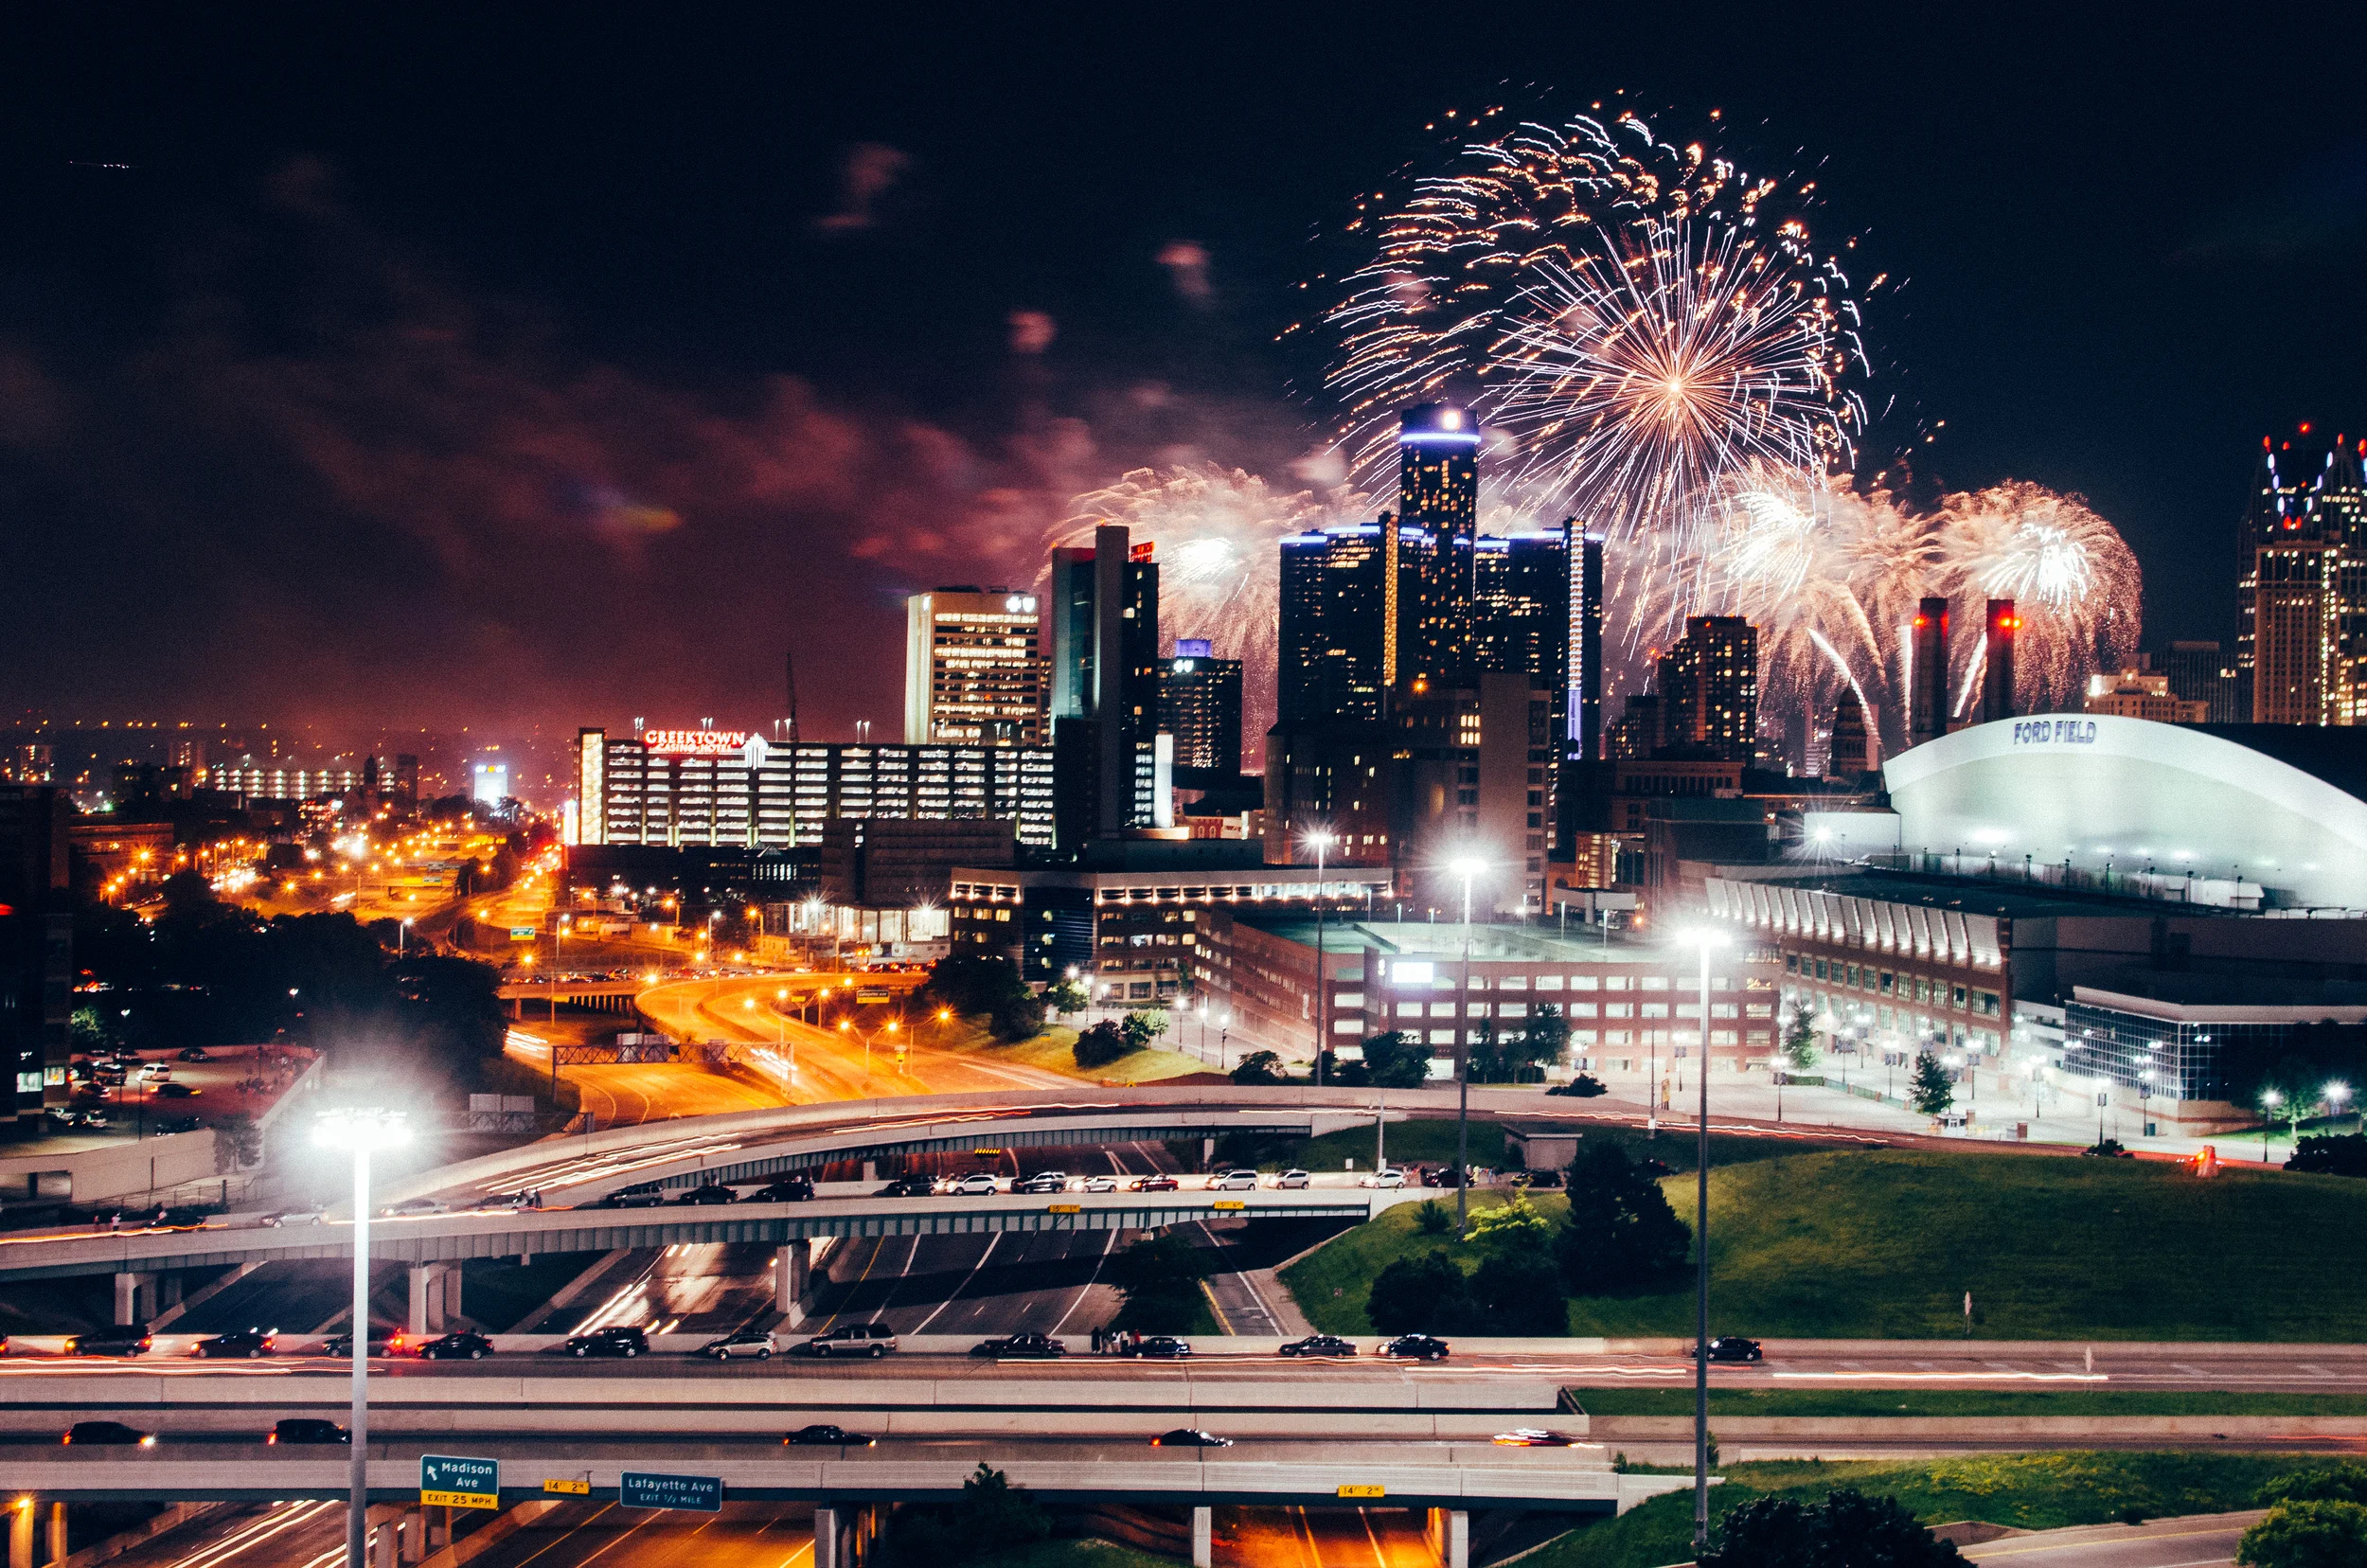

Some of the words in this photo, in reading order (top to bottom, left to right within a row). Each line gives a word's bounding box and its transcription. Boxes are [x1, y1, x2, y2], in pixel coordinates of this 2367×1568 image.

[645, 730, 745, 745] GREEKTOWN
[2014, 721, 2051, 744] FORD
[2055, 721, 2096, 743] FIELD
[441, 1463, 492, 1474] Madison
[456, 1477, 478, 1488] Ave
[629, 1478, 686, 1491] Lafayette
[691, 1482, 713, 1492] Ave
[427, 1494, 447, 1503] EXIT
[453, 1495, 467, 1504] 25
[472, 1497, 491, 1506] MPH
[640, 1493, 659, 1502] EXIT
[681, 1496, 702, 1505] MILE
